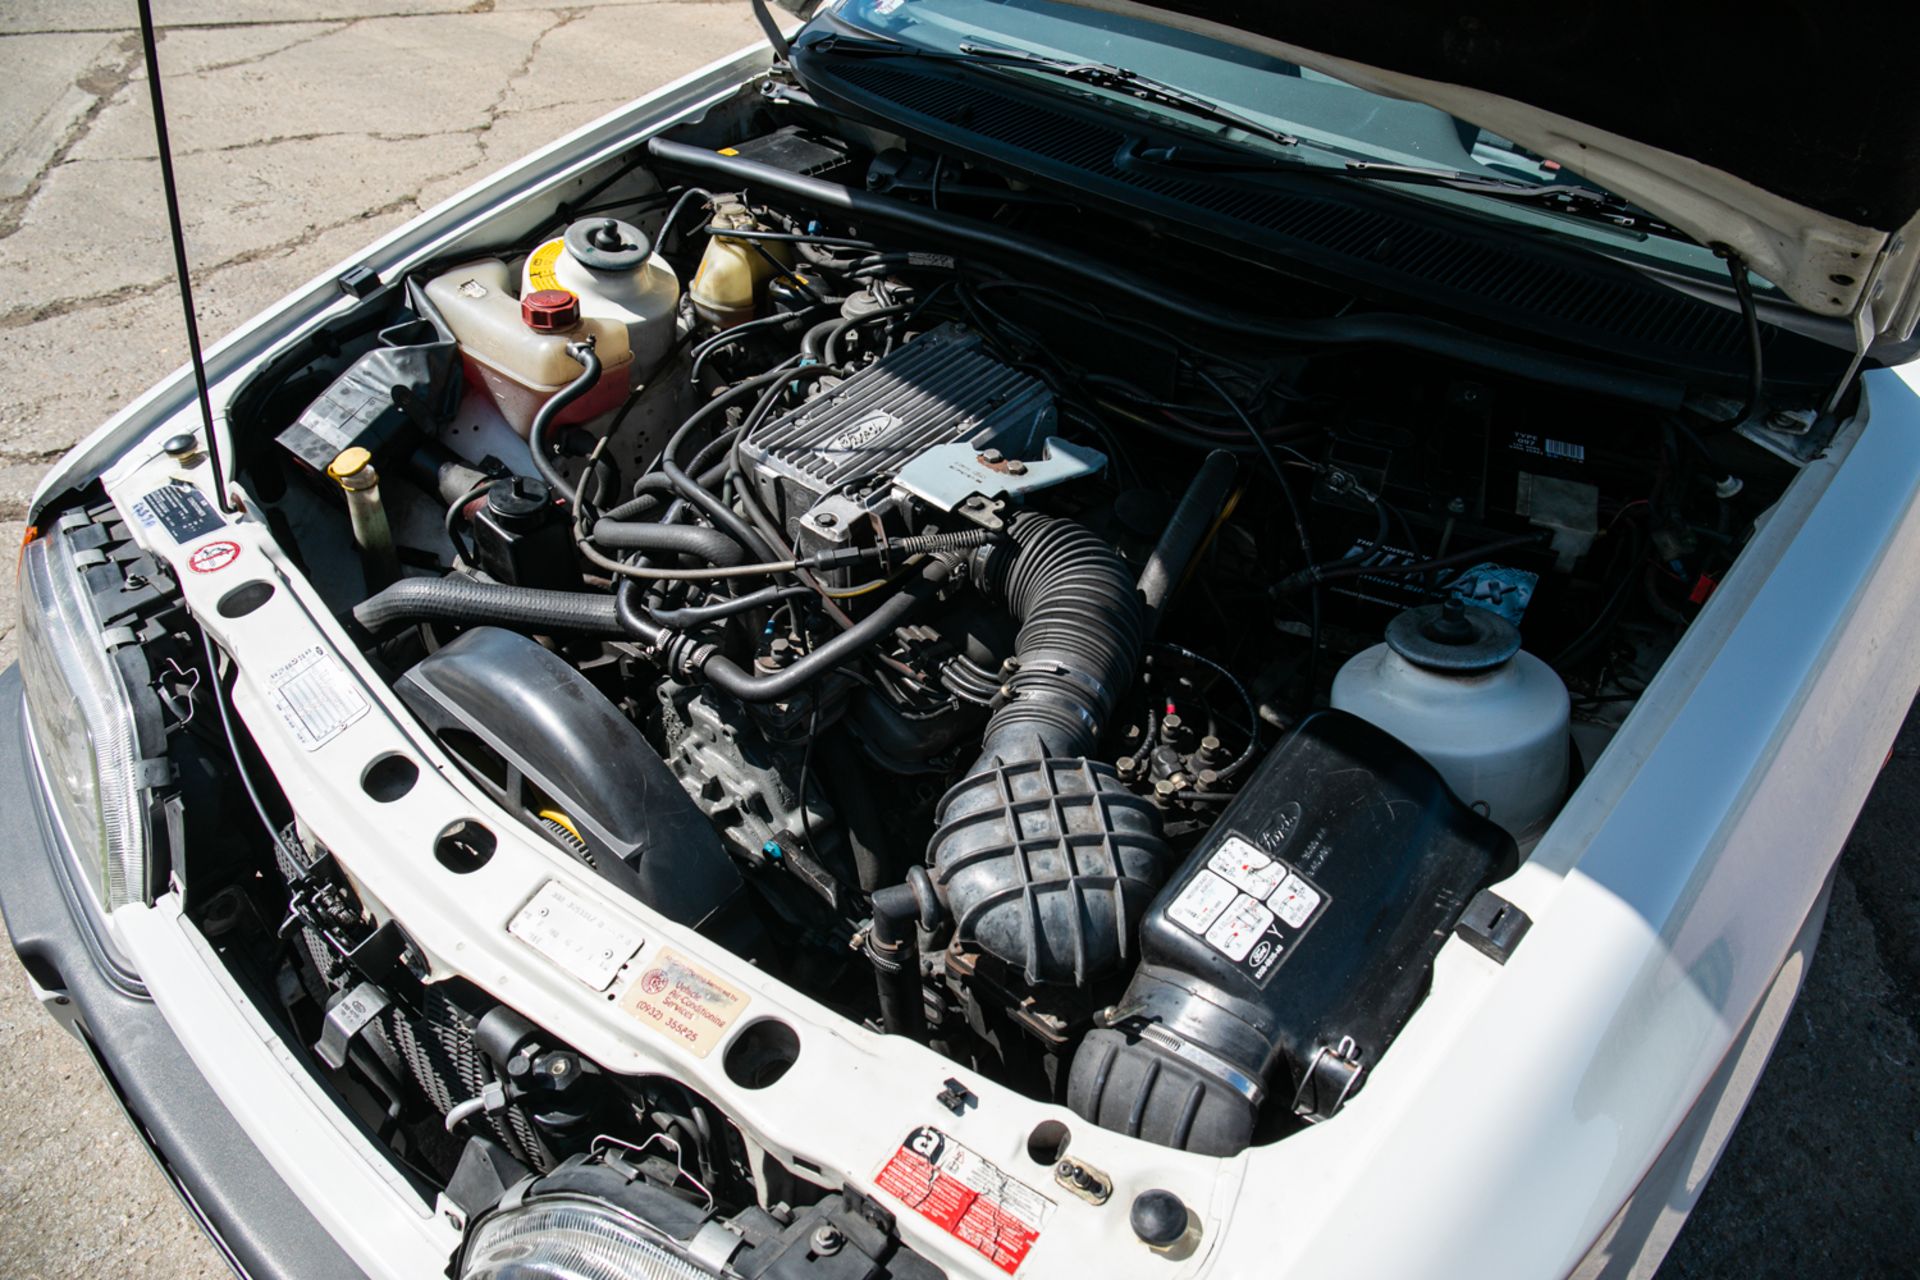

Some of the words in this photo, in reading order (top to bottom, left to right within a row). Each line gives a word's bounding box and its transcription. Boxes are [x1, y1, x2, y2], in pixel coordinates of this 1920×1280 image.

[1258, 812, 1298, 850] Ford
[1266, 923, 1284, 939] Y
[675, 980, 704, 1001] Vehicle
[636, 1000, 664, 1022] (0932)
[662, 997, 694, 1021] Services
